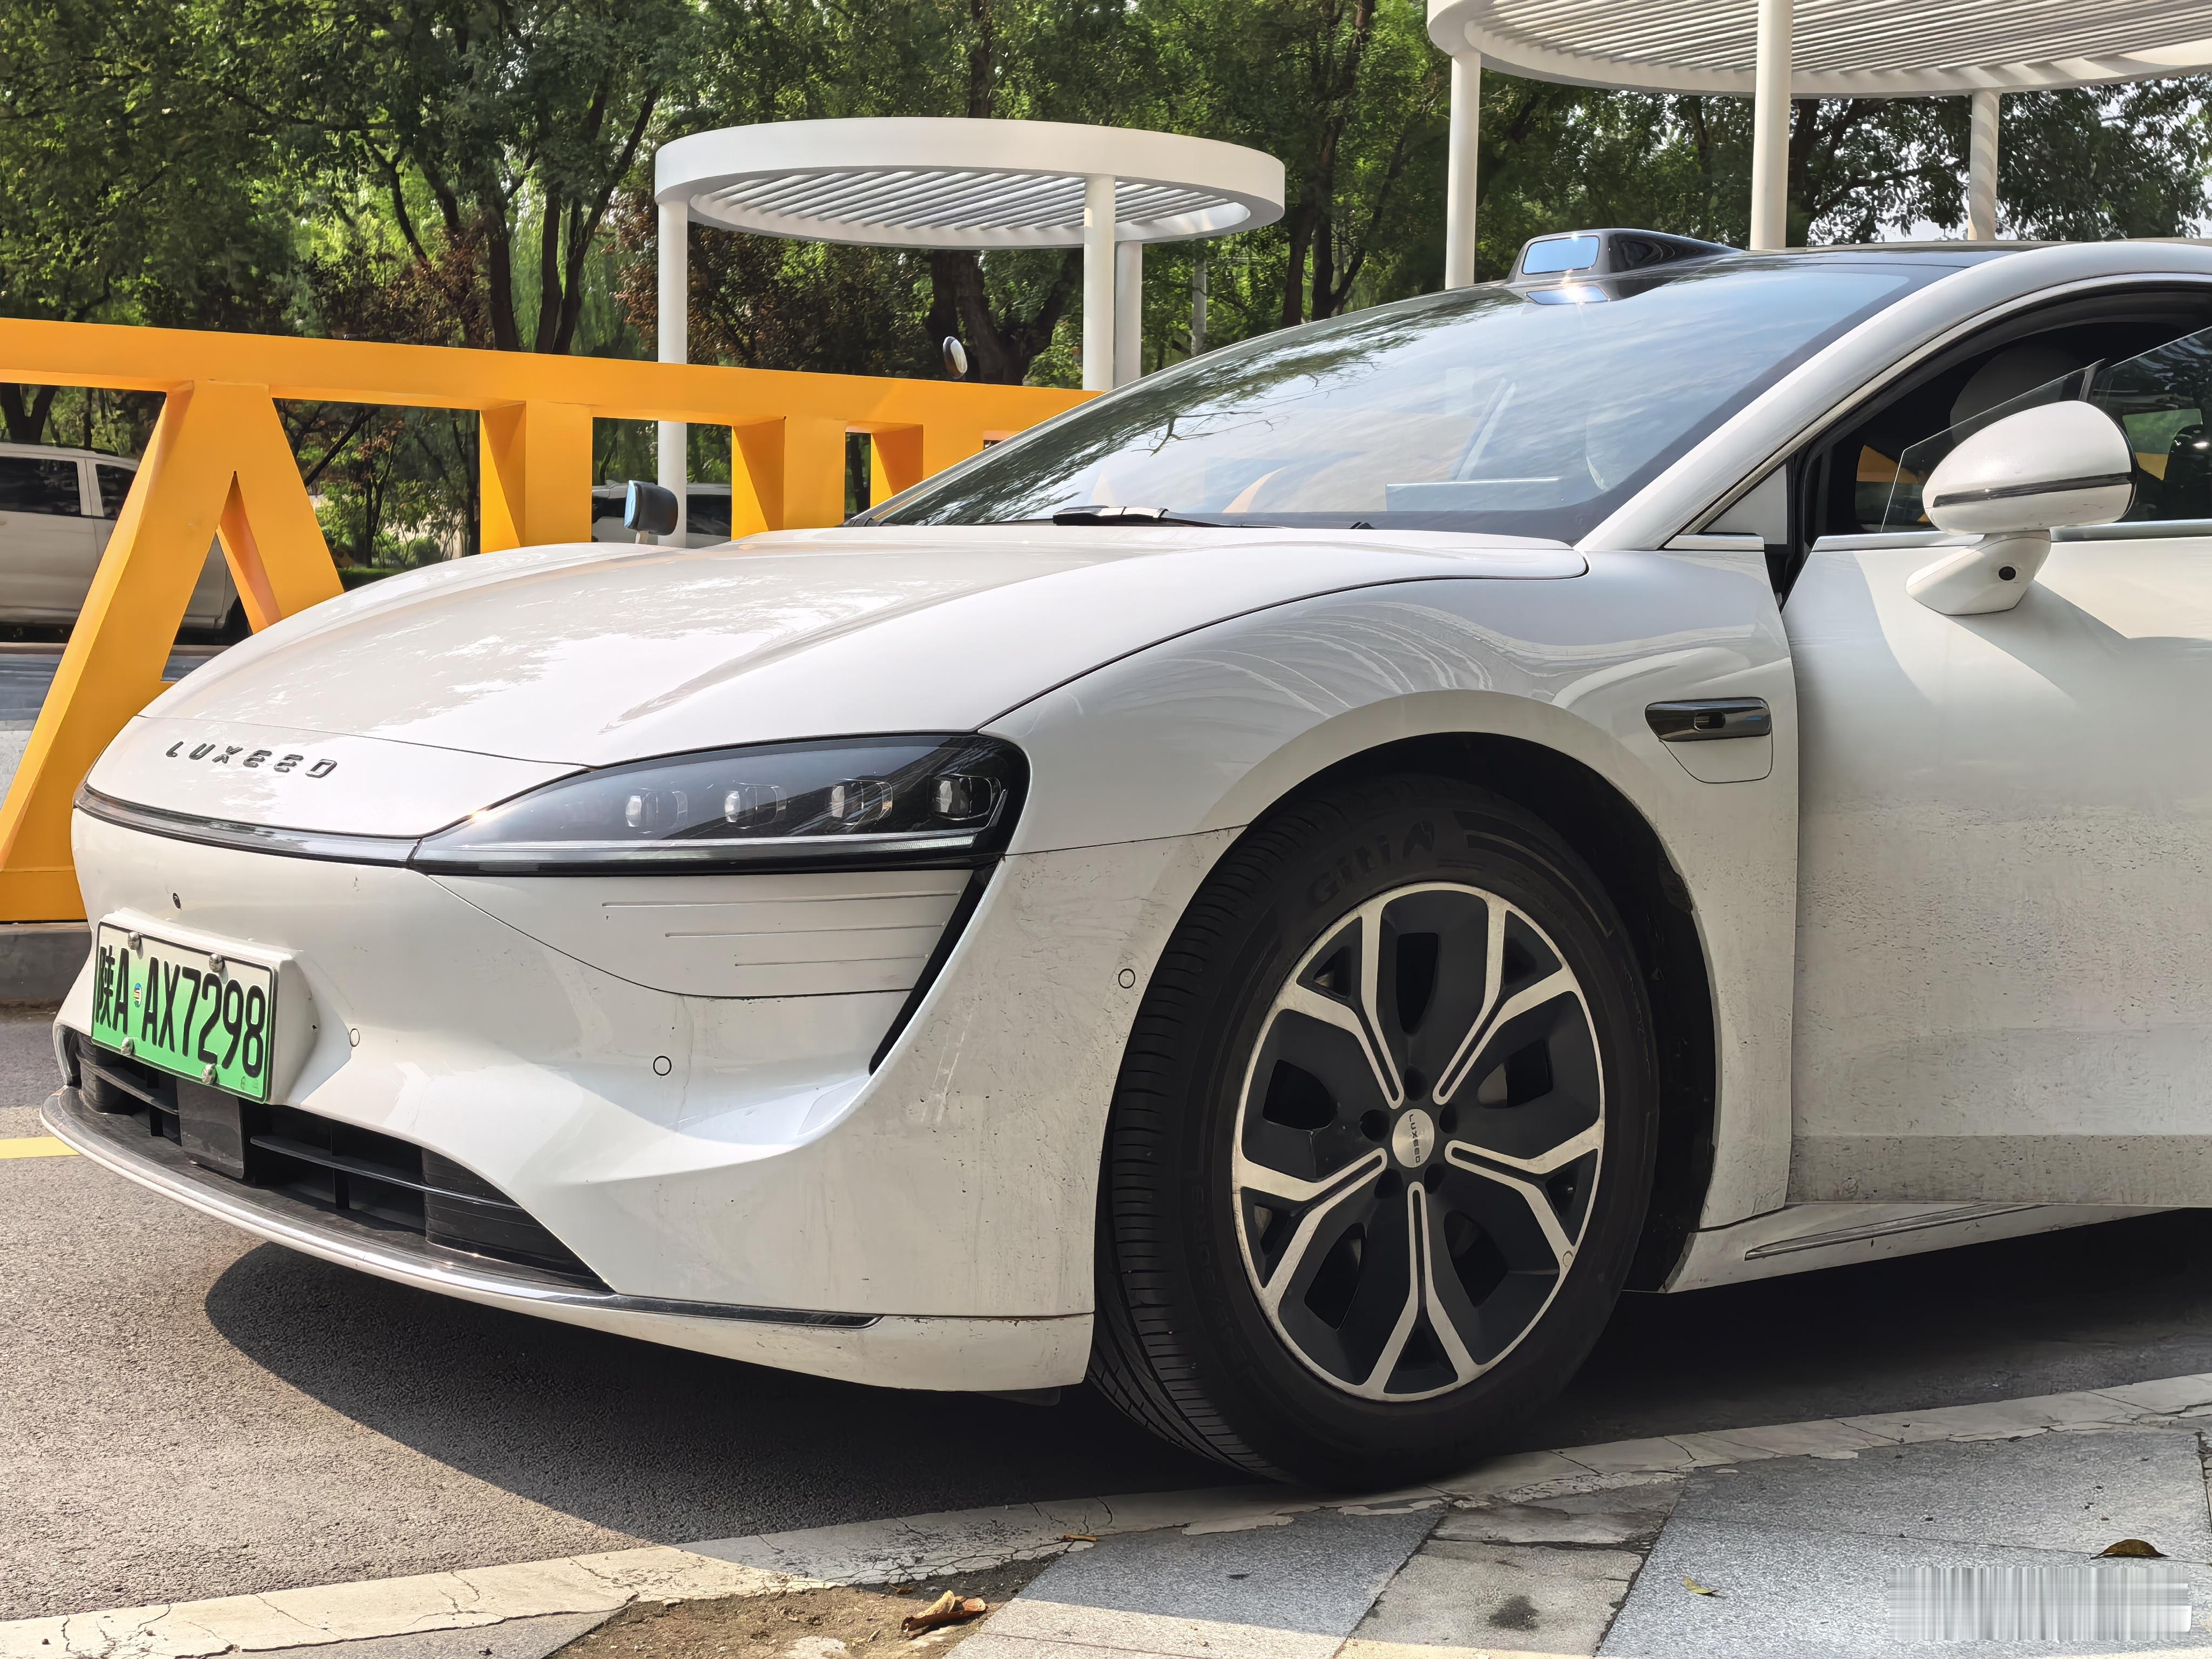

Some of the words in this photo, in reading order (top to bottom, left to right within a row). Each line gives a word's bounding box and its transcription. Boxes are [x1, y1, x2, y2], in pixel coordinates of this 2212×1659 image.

[166, 741, 337, 778] LUXEED
[1307, 834, 1391, 906] Giti
[1409, 1114, 1420, 1163] LUXEED
